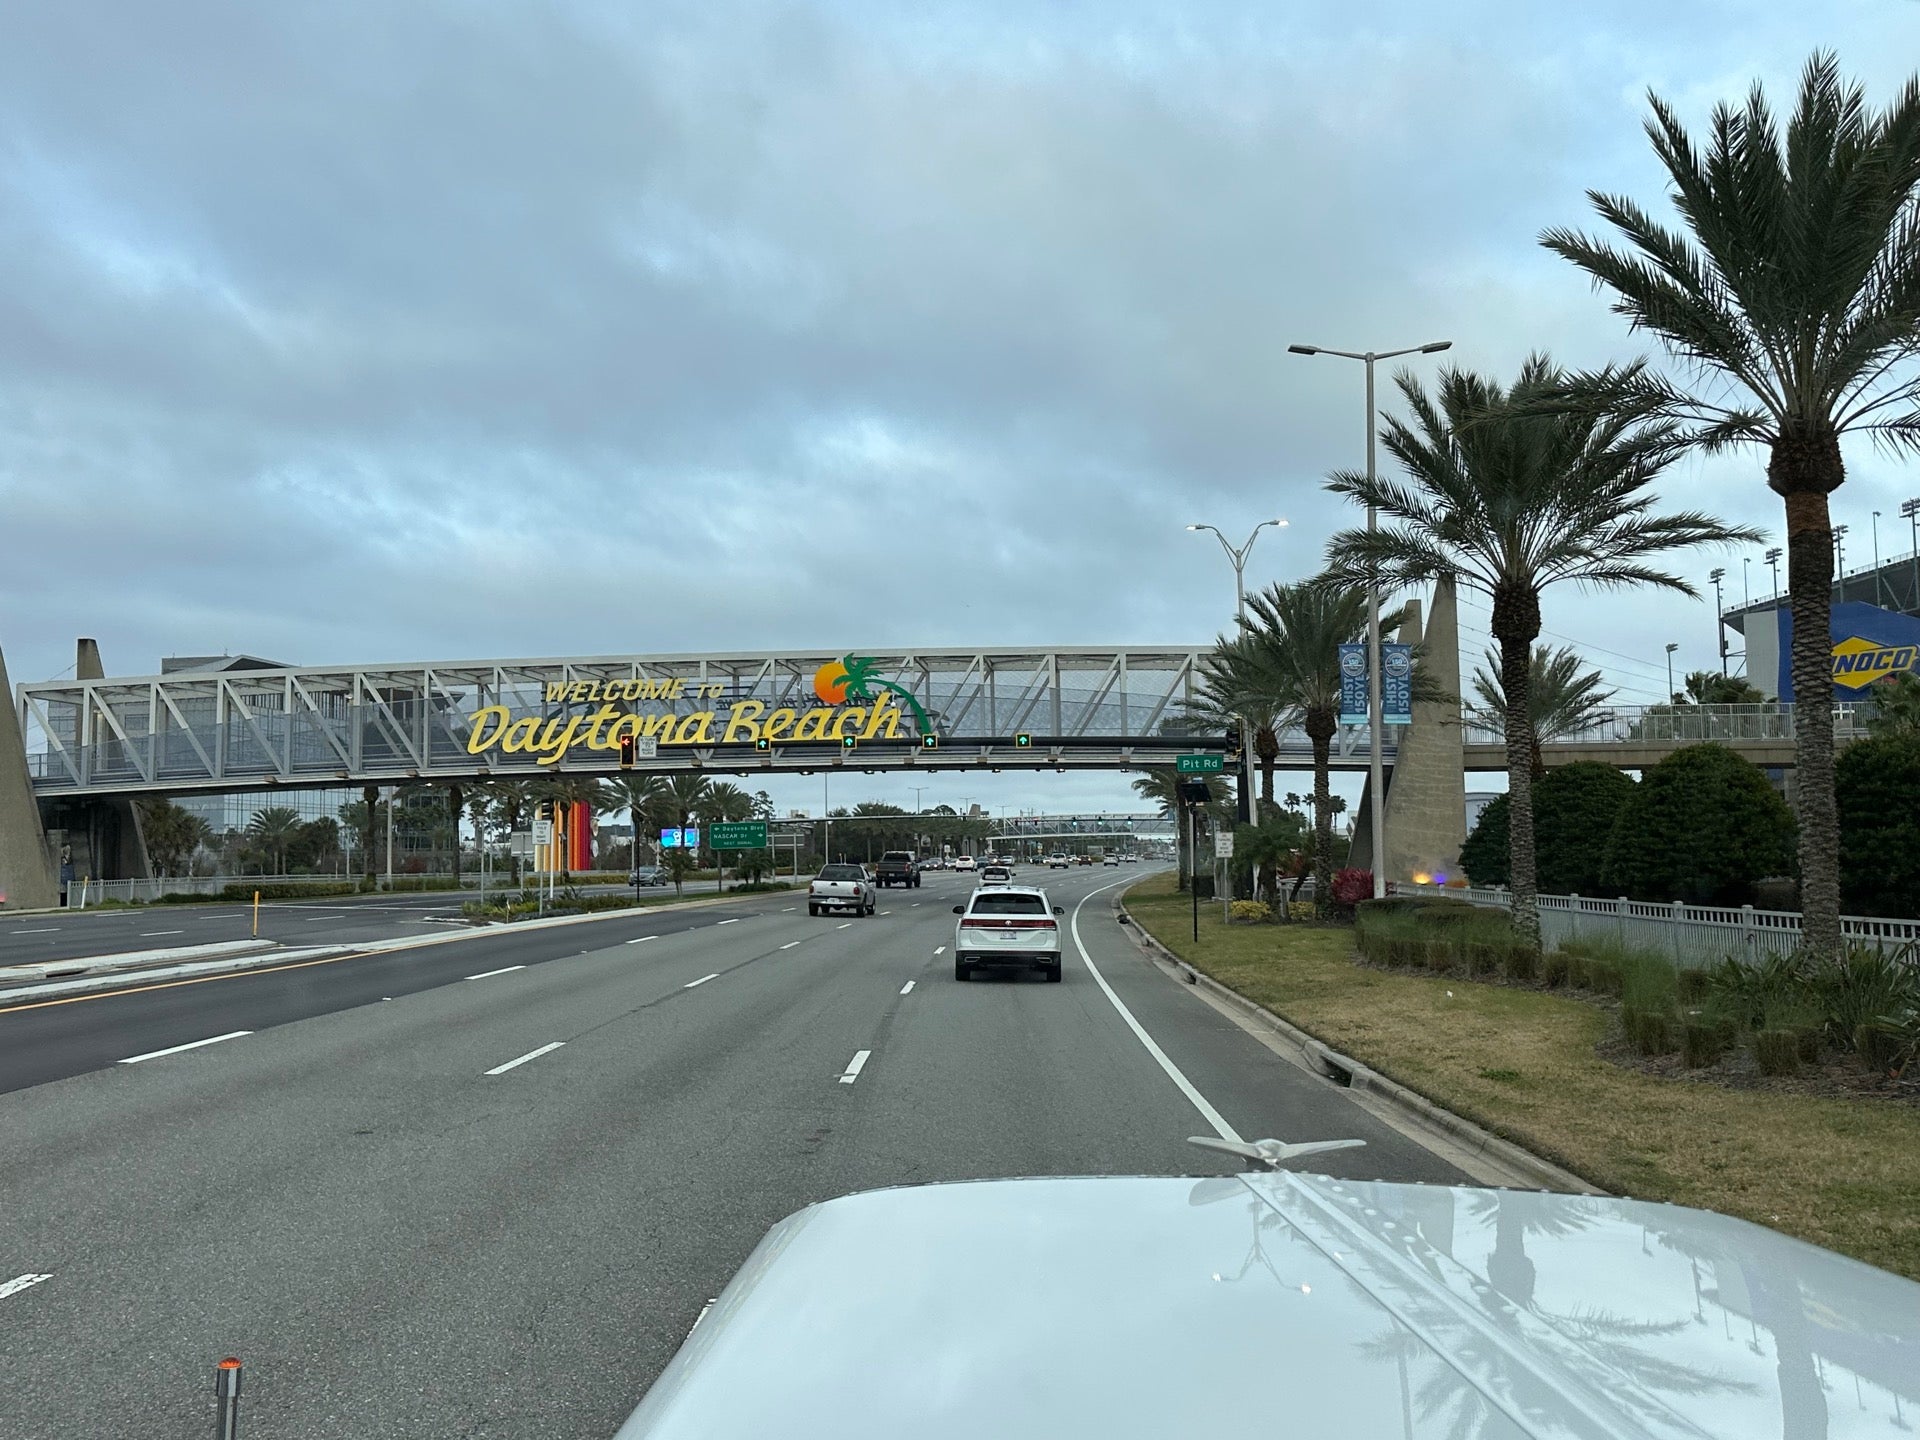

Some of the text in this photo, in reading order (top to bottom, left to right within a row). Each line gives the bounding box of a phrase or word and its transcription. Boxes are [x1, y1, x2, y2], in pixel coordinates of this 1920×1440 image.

[1831, 649, 1913, 673] NOCO
[545, 678, 688, 702] WELCOME
[697, 683, 724, 699] TO
[467, 703, 715, 765] Daytona
[723, 692, 904, 743] Beach
[1182, 759, 1218, 769] Pit Rd
[722, 825, 748, 833] Daytona
